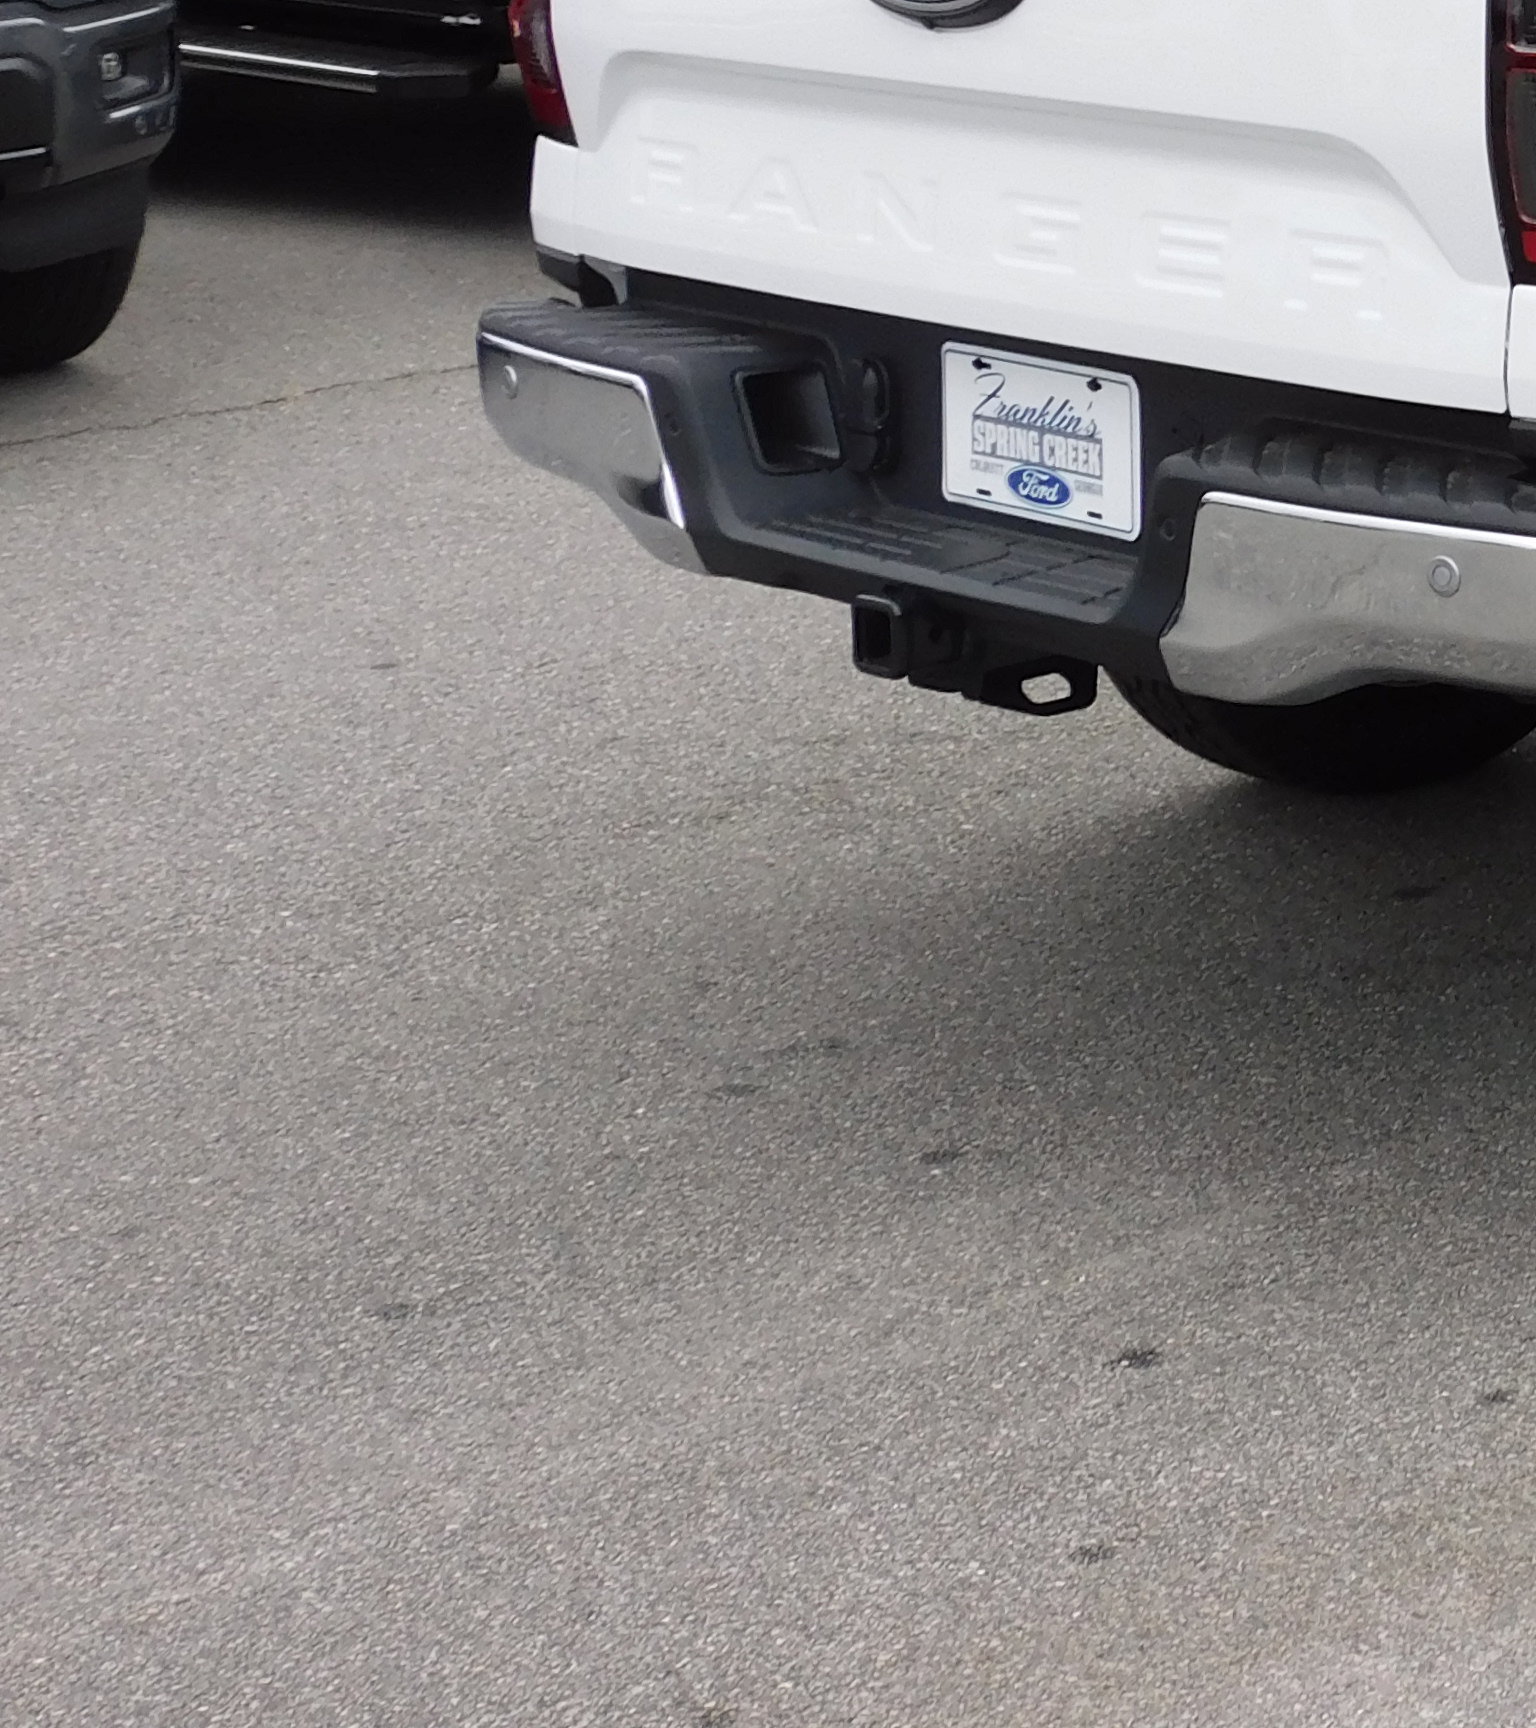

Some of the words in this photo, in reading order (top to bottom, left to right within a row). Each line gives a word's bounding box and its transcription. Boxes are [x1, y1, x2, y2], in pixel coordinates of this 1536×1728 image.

[630, 136, 1389, 321] RANGER
[971, 372, 1098, 439] Franklin's
[973, 420, 1041, 463] SPRING
[1043, 432, 1102, 478] CREEK
[1018, 470, 1060, 502] Ford
